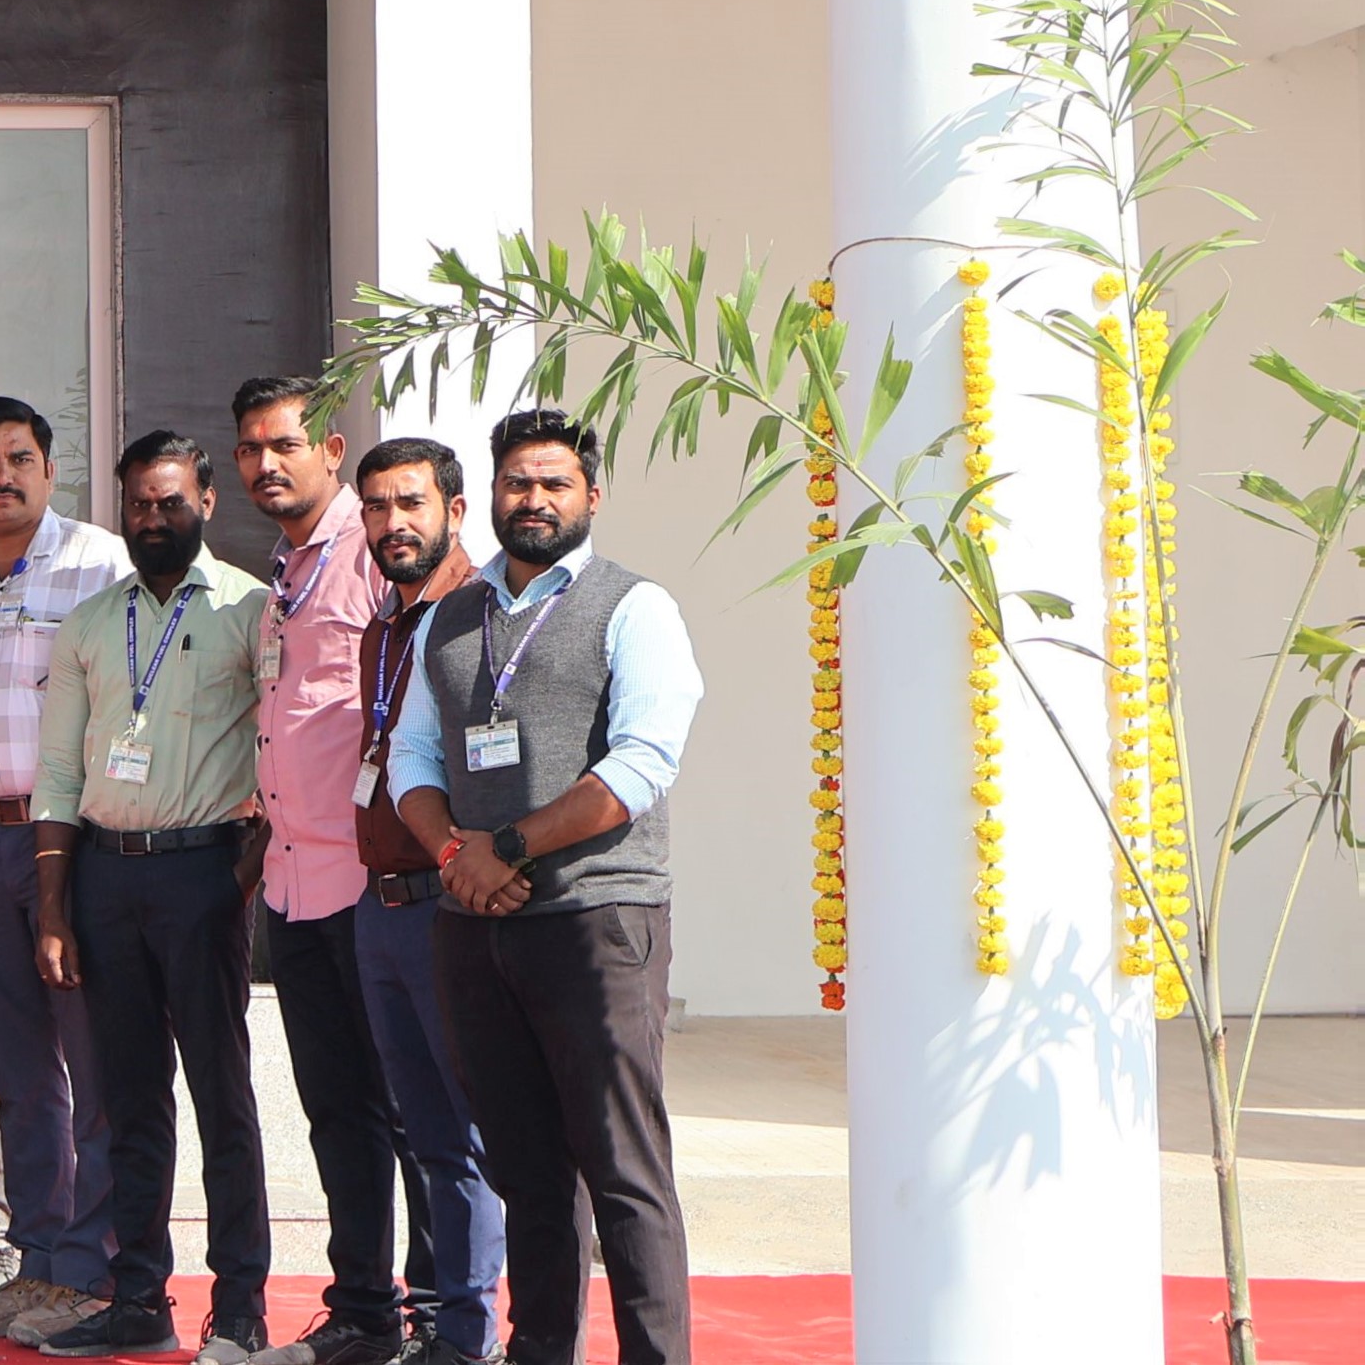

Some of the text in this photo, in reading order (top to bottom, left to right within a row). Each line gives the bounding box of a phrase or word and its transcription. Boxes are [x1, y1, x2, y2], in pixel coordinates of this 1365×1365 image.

[144, 616, 178, 685] NUCLEAR FUEL COMPLEX
[509, 634, 530, 663] NUCLEAR
[526, 620, 539, 636] FUEL
